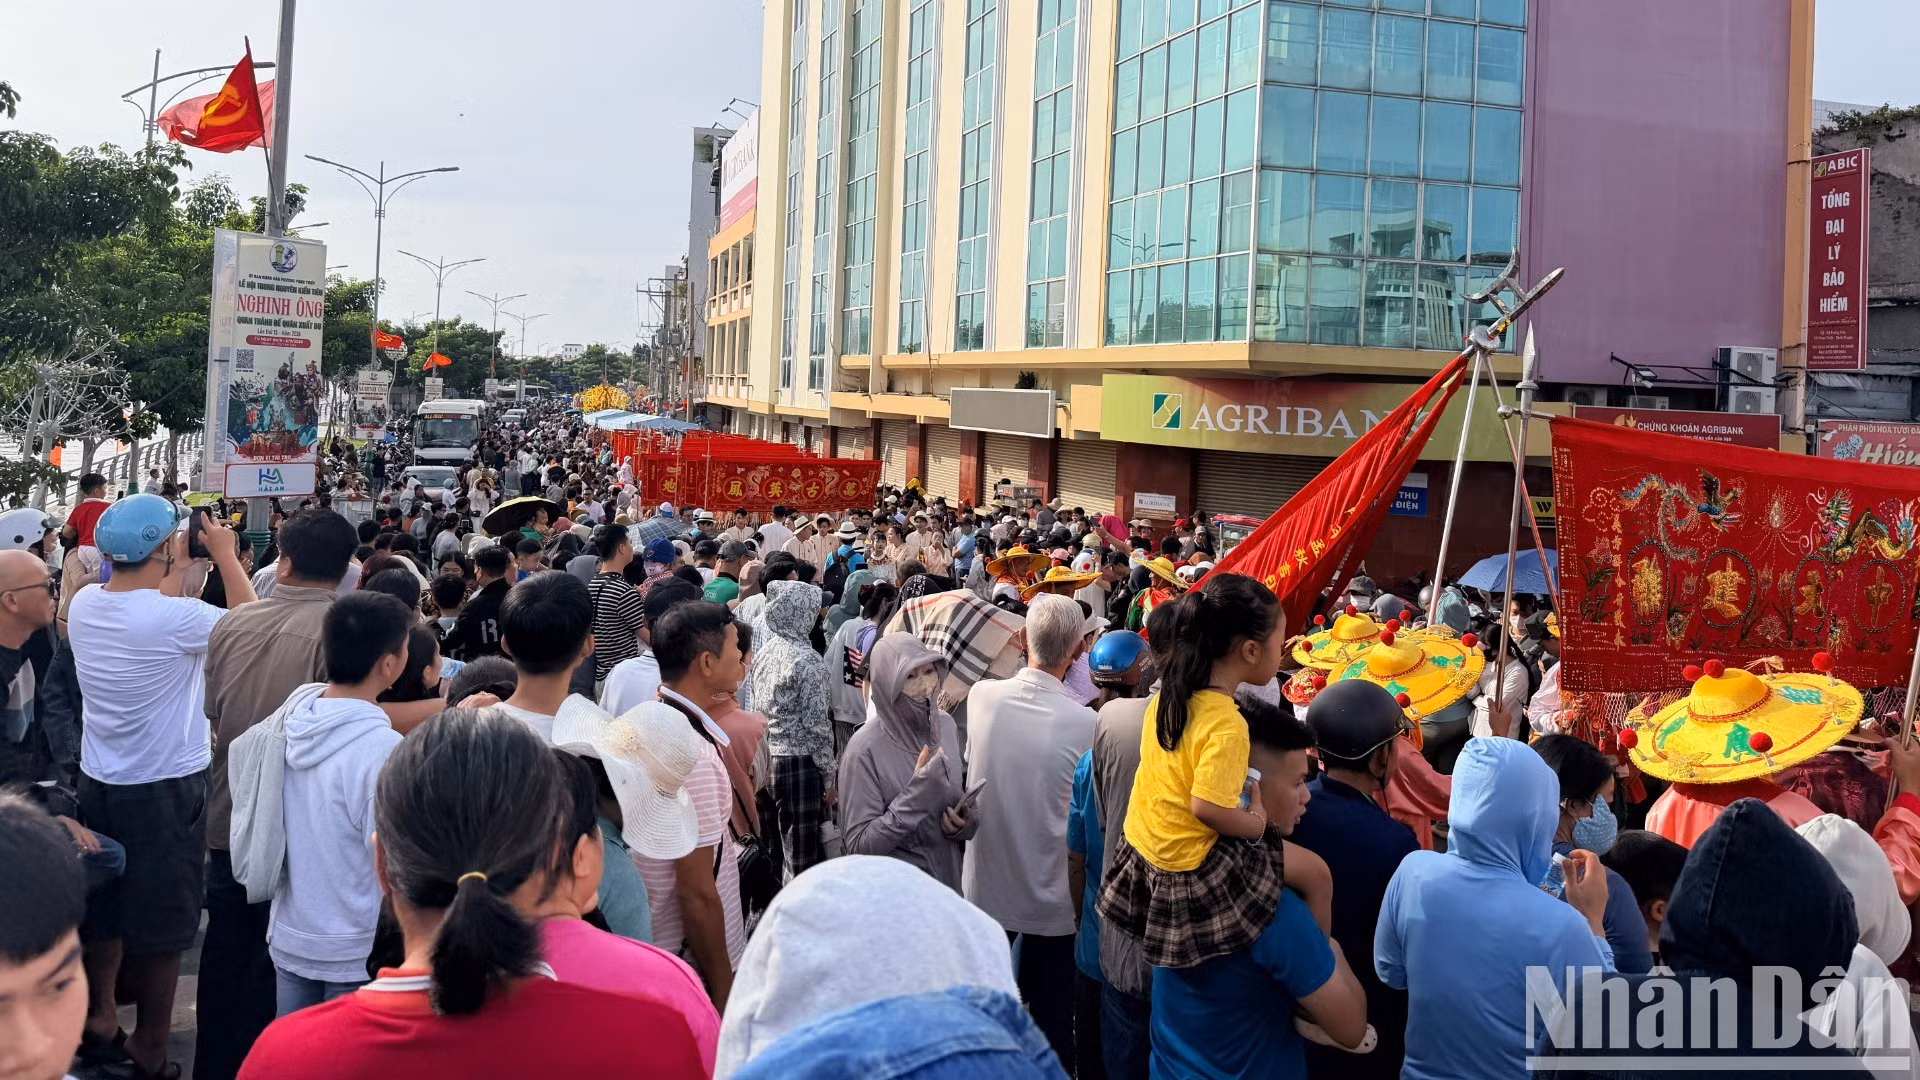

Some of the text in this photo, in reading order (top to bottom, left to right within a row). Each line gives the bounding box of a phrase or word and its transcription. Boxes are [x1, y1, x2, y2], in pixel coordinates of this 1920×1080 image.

[1827, 155, 1858, 171] ABIC
[1821, 187, 1850, 209] TỔNG
[1825, 218, 1845, 236] ĐẠI
[1828, 242, 1841, 260] LÝ
[1823, 267, 1845, 287] BẢO
[237, 293, 291, 316] NGHINH
[296, 296, 323, 319] ÔNG
[1820, 292, 1848, 312] HIỂM
[1637, 421, 1744, 435] CHỨNG KHOÁN AGRIBANK
[1877, 425, 1892, 434] HOA
[1398, 491, 1419, 500] THU
[1395, 500, 1419, 511] ĐIỆN
